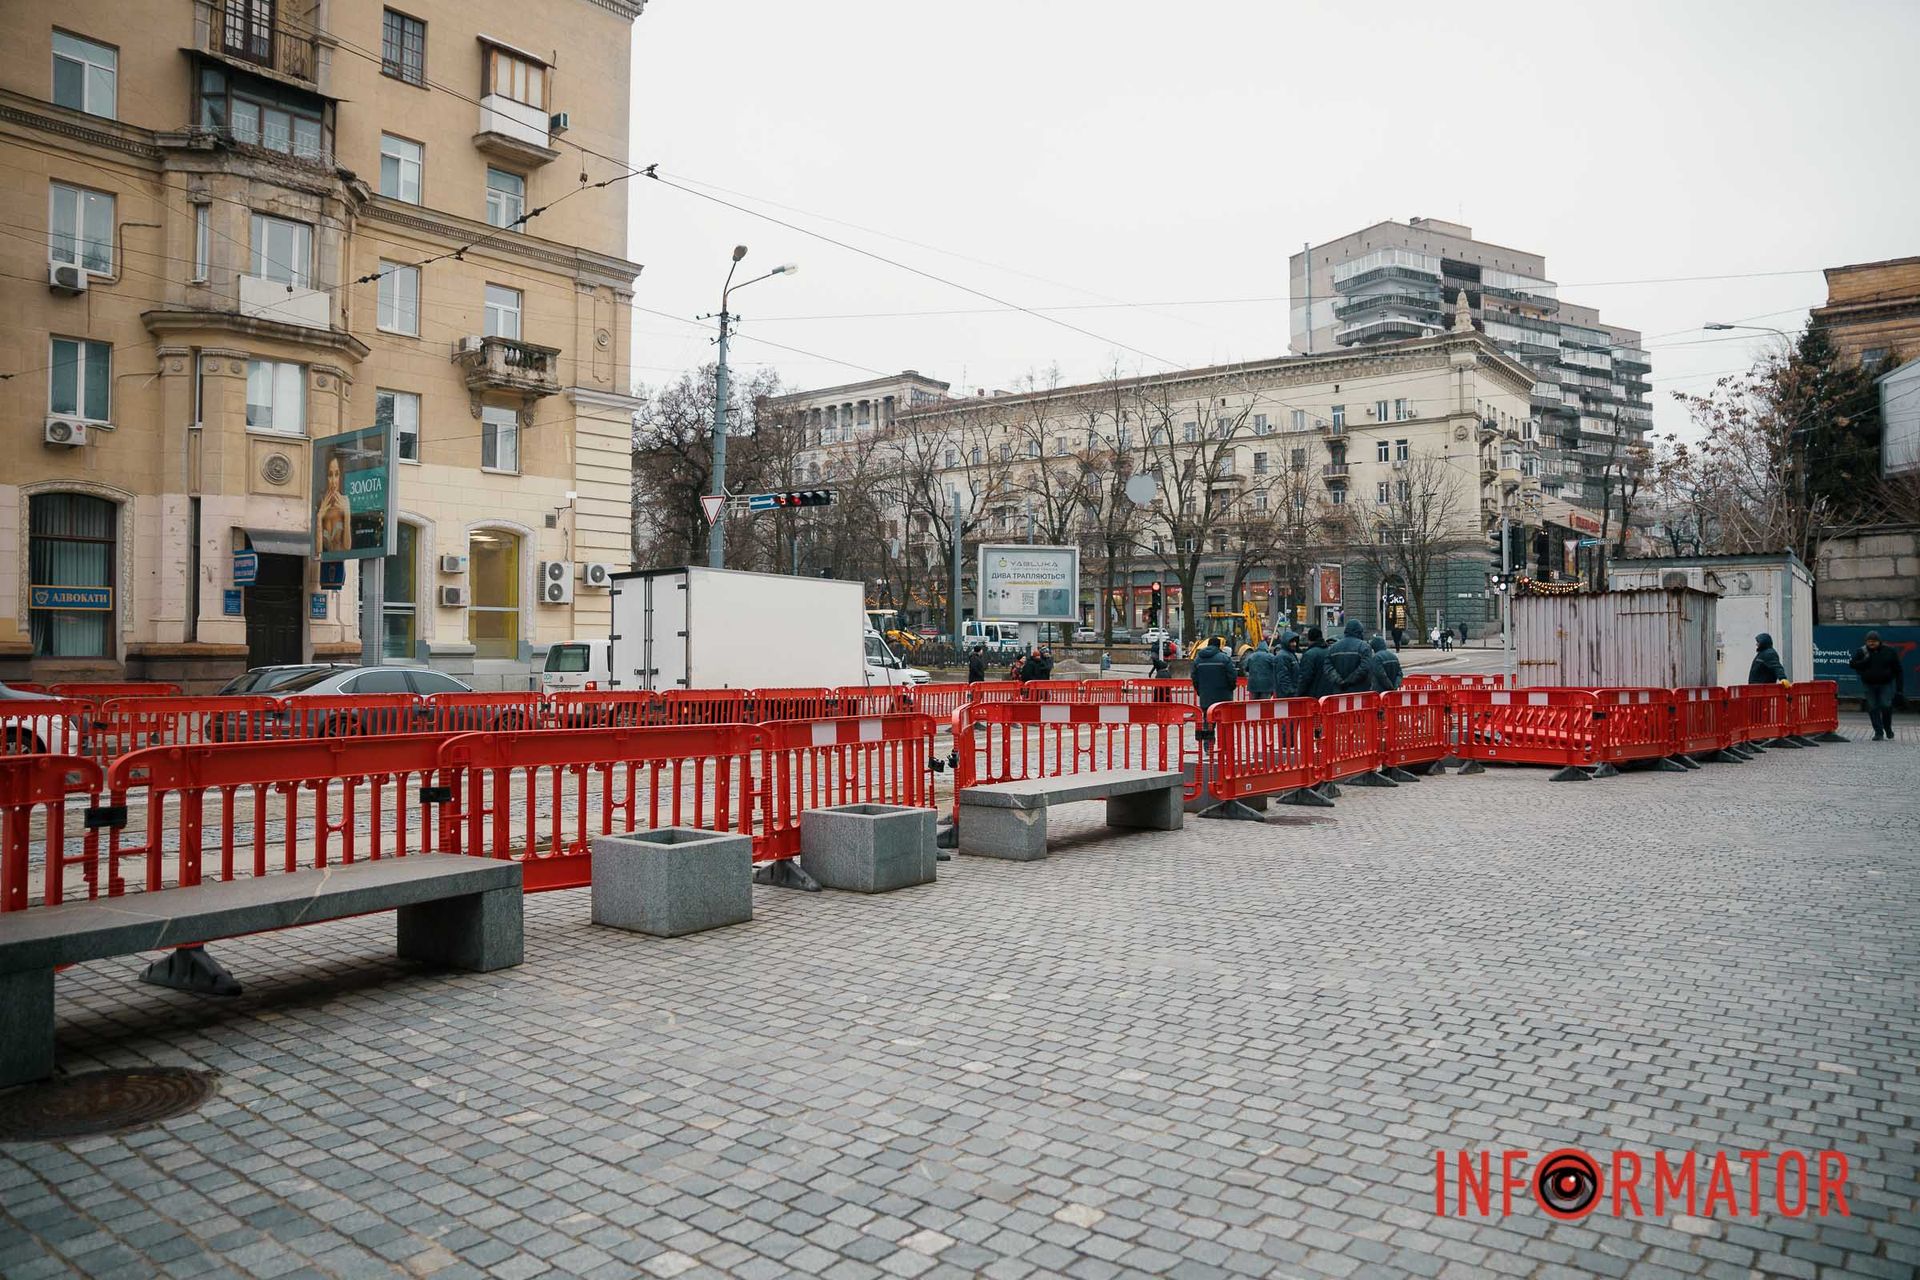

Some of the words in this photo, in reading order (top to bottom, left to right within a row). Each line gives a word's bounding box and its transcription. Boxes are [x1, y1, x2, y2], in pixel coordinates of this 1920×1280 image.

[349, 477, 382, 495] ЗОЛОТА
[991, 572, 1012, 580] ДИВА
[1013, 572, 1066, 580] ТРАПЛЯЮТЬСЯ
[52, 592, 107, 603] АДВОКАТИ
